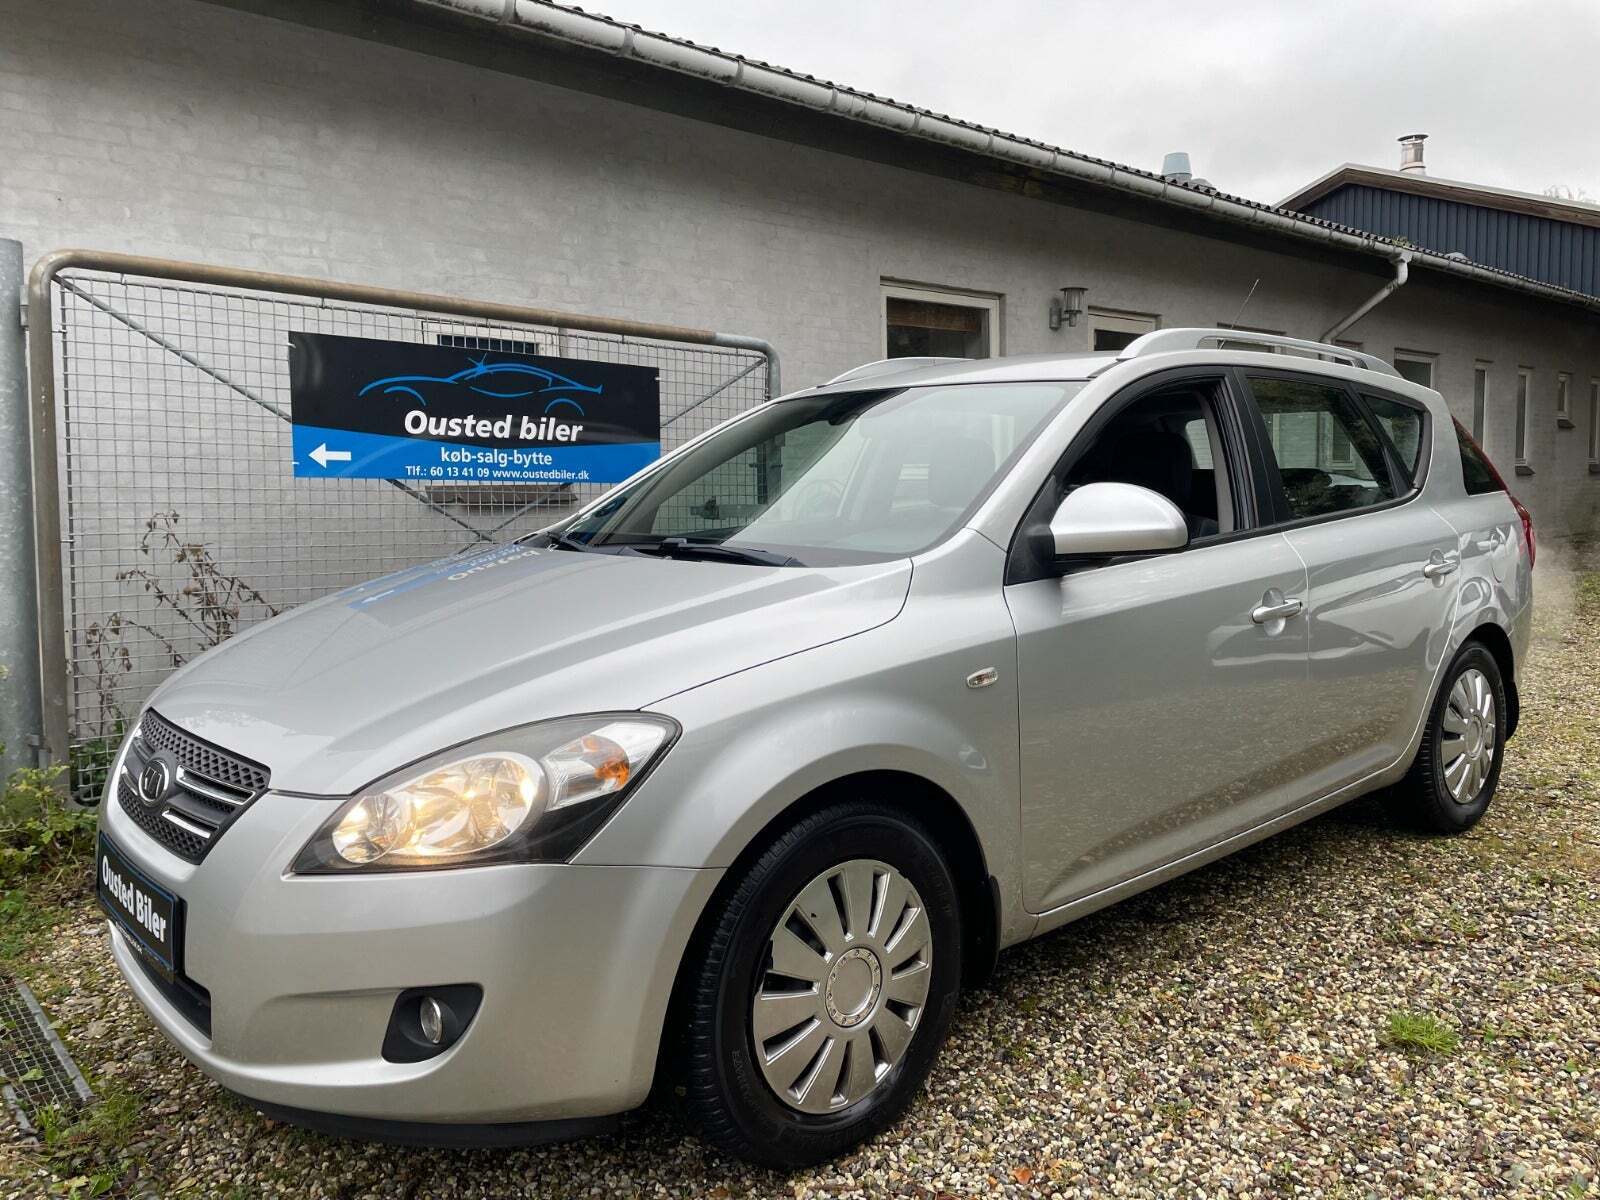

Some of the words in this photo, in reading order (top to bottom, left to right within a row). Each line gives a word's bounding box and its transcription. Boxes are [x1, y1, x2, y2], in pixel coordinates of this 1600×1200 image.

[404, 410, 513, 438] Ousted
[519, 415, 583, 442] biler
[440, 447, 553, 468] køb-salg-bytte
[405, 466, 427, 477] Tlf.:
[430, 467, 443, 477] 60
[447, 467, 459, 477] 13
[461, 467, 474, 477] 41
[477, 468, 490, 478] 09
[492, 469, 590, 480] www.oustedbiler.dk
[102, 855, 134, 916] Ousted
[136, 889, 166, 943] Biler
